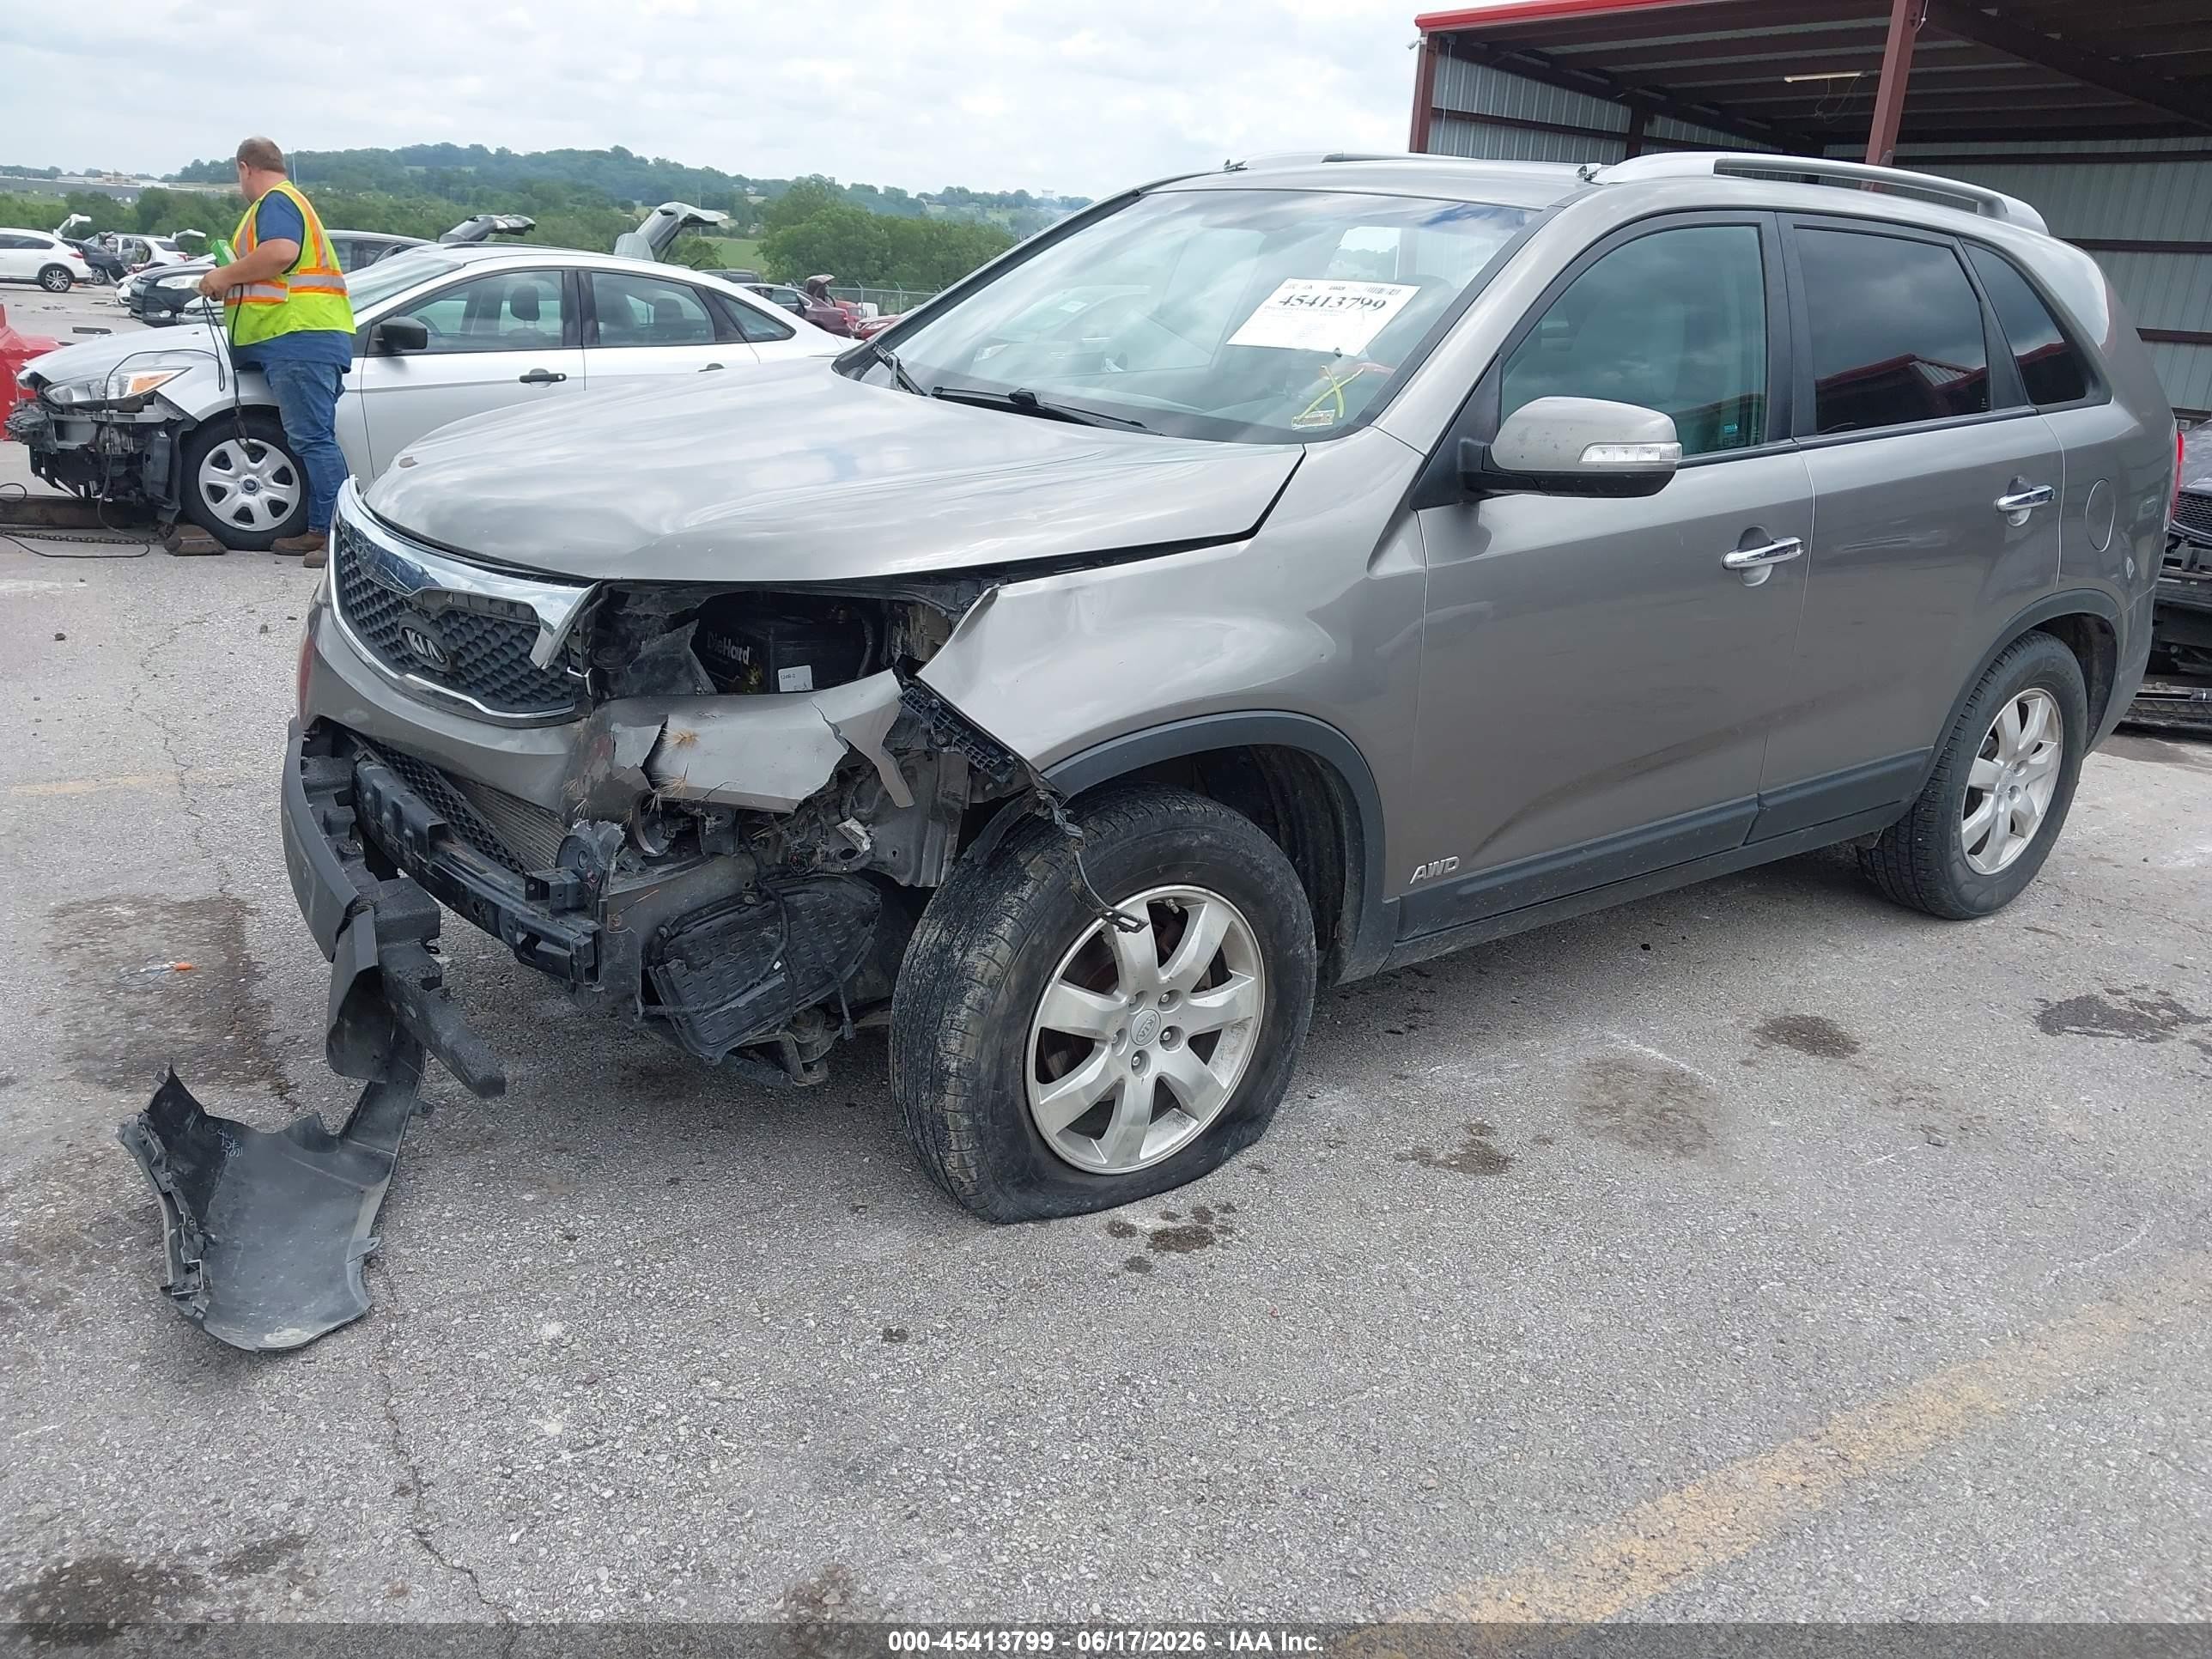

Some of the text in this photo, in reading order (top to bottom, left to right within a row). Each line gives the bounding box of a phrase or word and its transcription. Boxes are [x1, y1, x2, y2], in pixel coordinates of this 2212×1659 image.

[1278, 294, 1387, 312] 45413799
[404, 628, 445, 663] KIA
[1409, 855, 1460, 884] AWD
[1139, 1018, 1155, 1038] KIA
